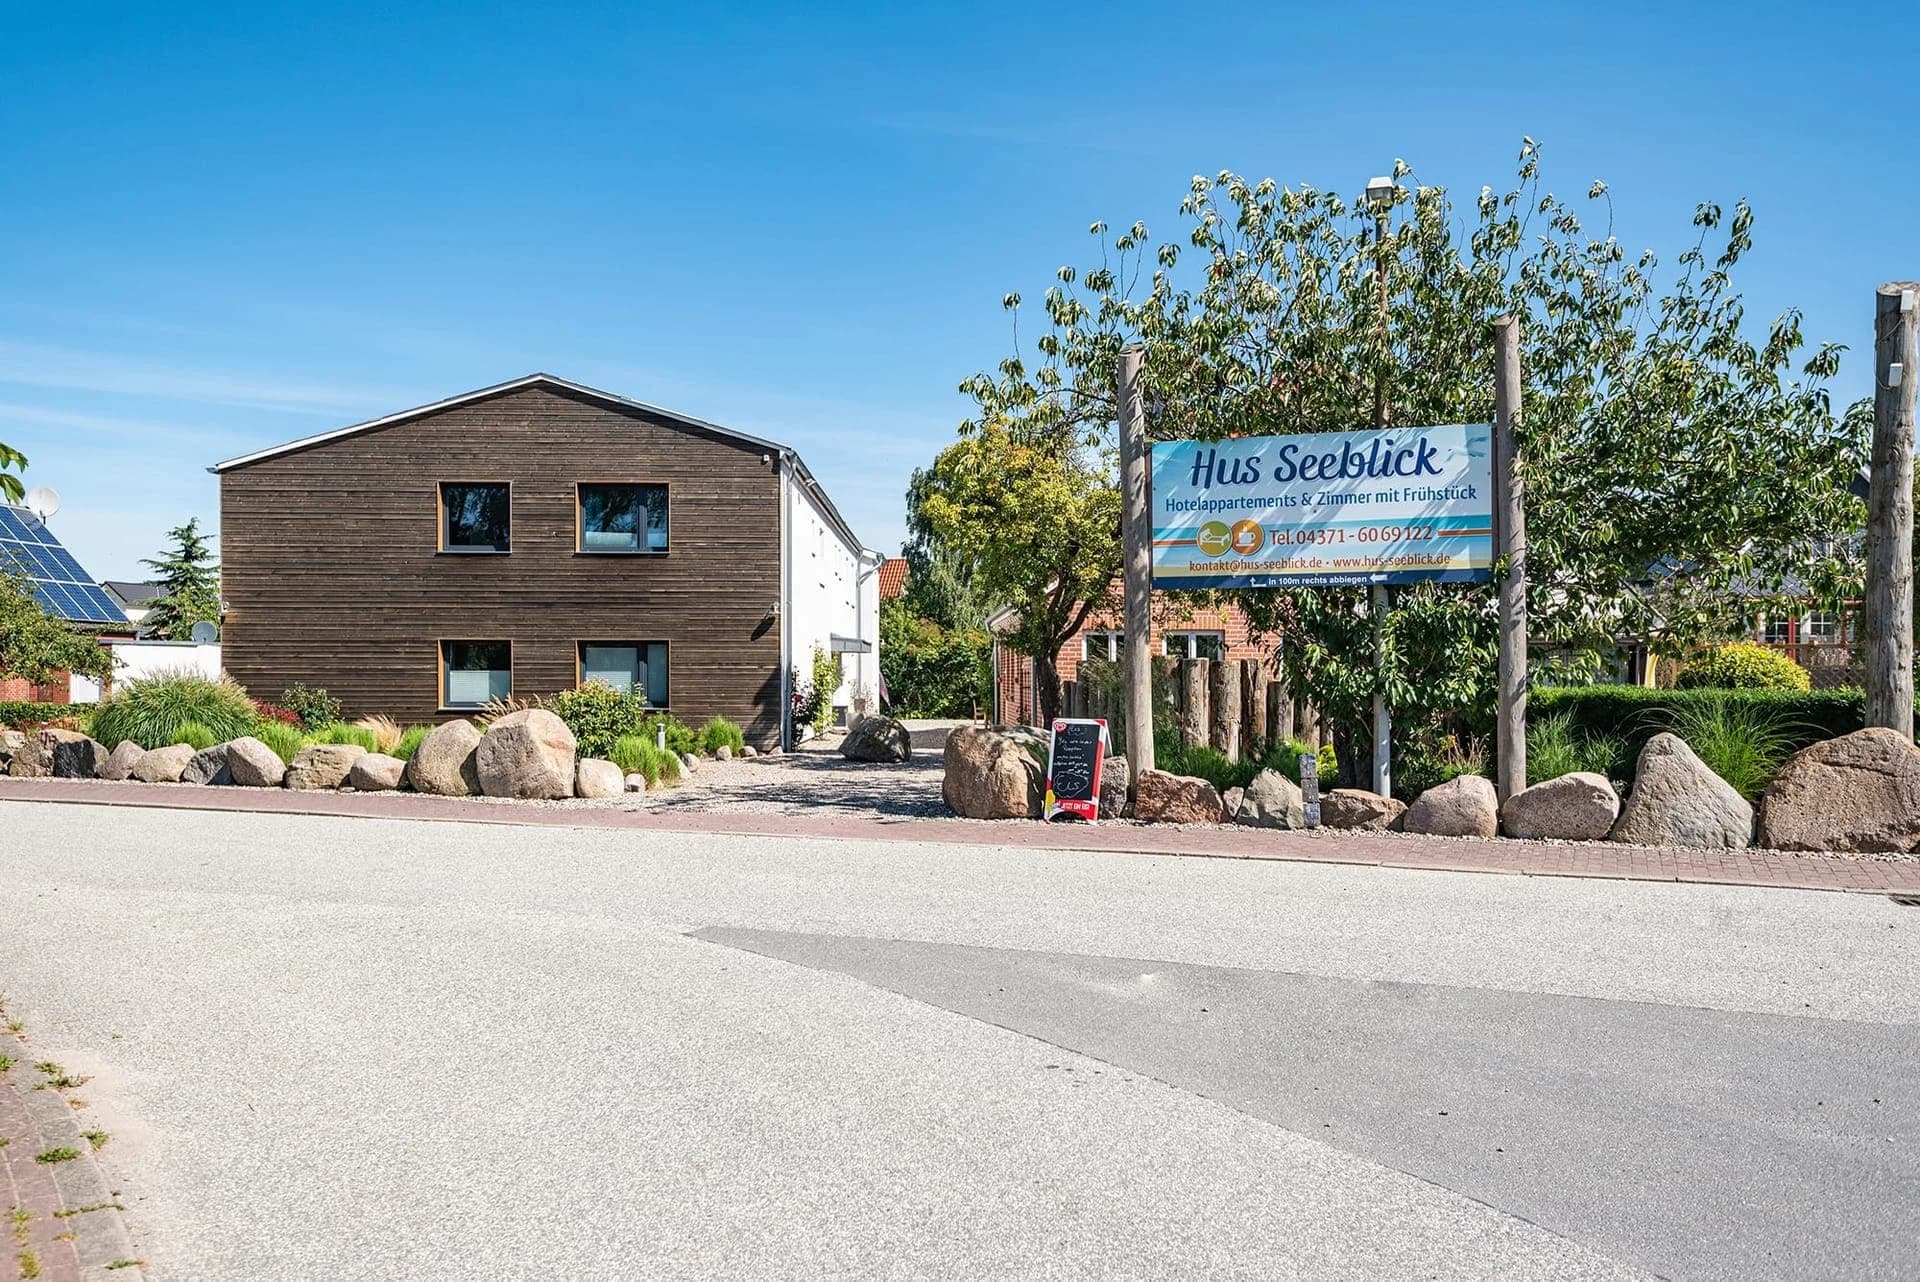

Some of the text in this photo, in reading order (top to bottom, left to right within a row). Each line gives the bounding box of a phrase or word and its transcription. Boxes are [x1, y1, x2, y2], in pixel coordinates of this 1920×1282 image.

[1191, 437, 1443, 489] Hus Seeblick
[1165, 484, 1477, 513] Hotelappartements & Zimmer mit Frühstück
[1189, 557, 1322, 572] kontakt@hus-seeblick.de
[1333, 553, 1450, 567] www.hus-seeblick.de
[1279, 576, 1300, 585] 100m
[1301, 575, 1327, 585] rechts
[1329, 575, 1368, 587] abbiegen
